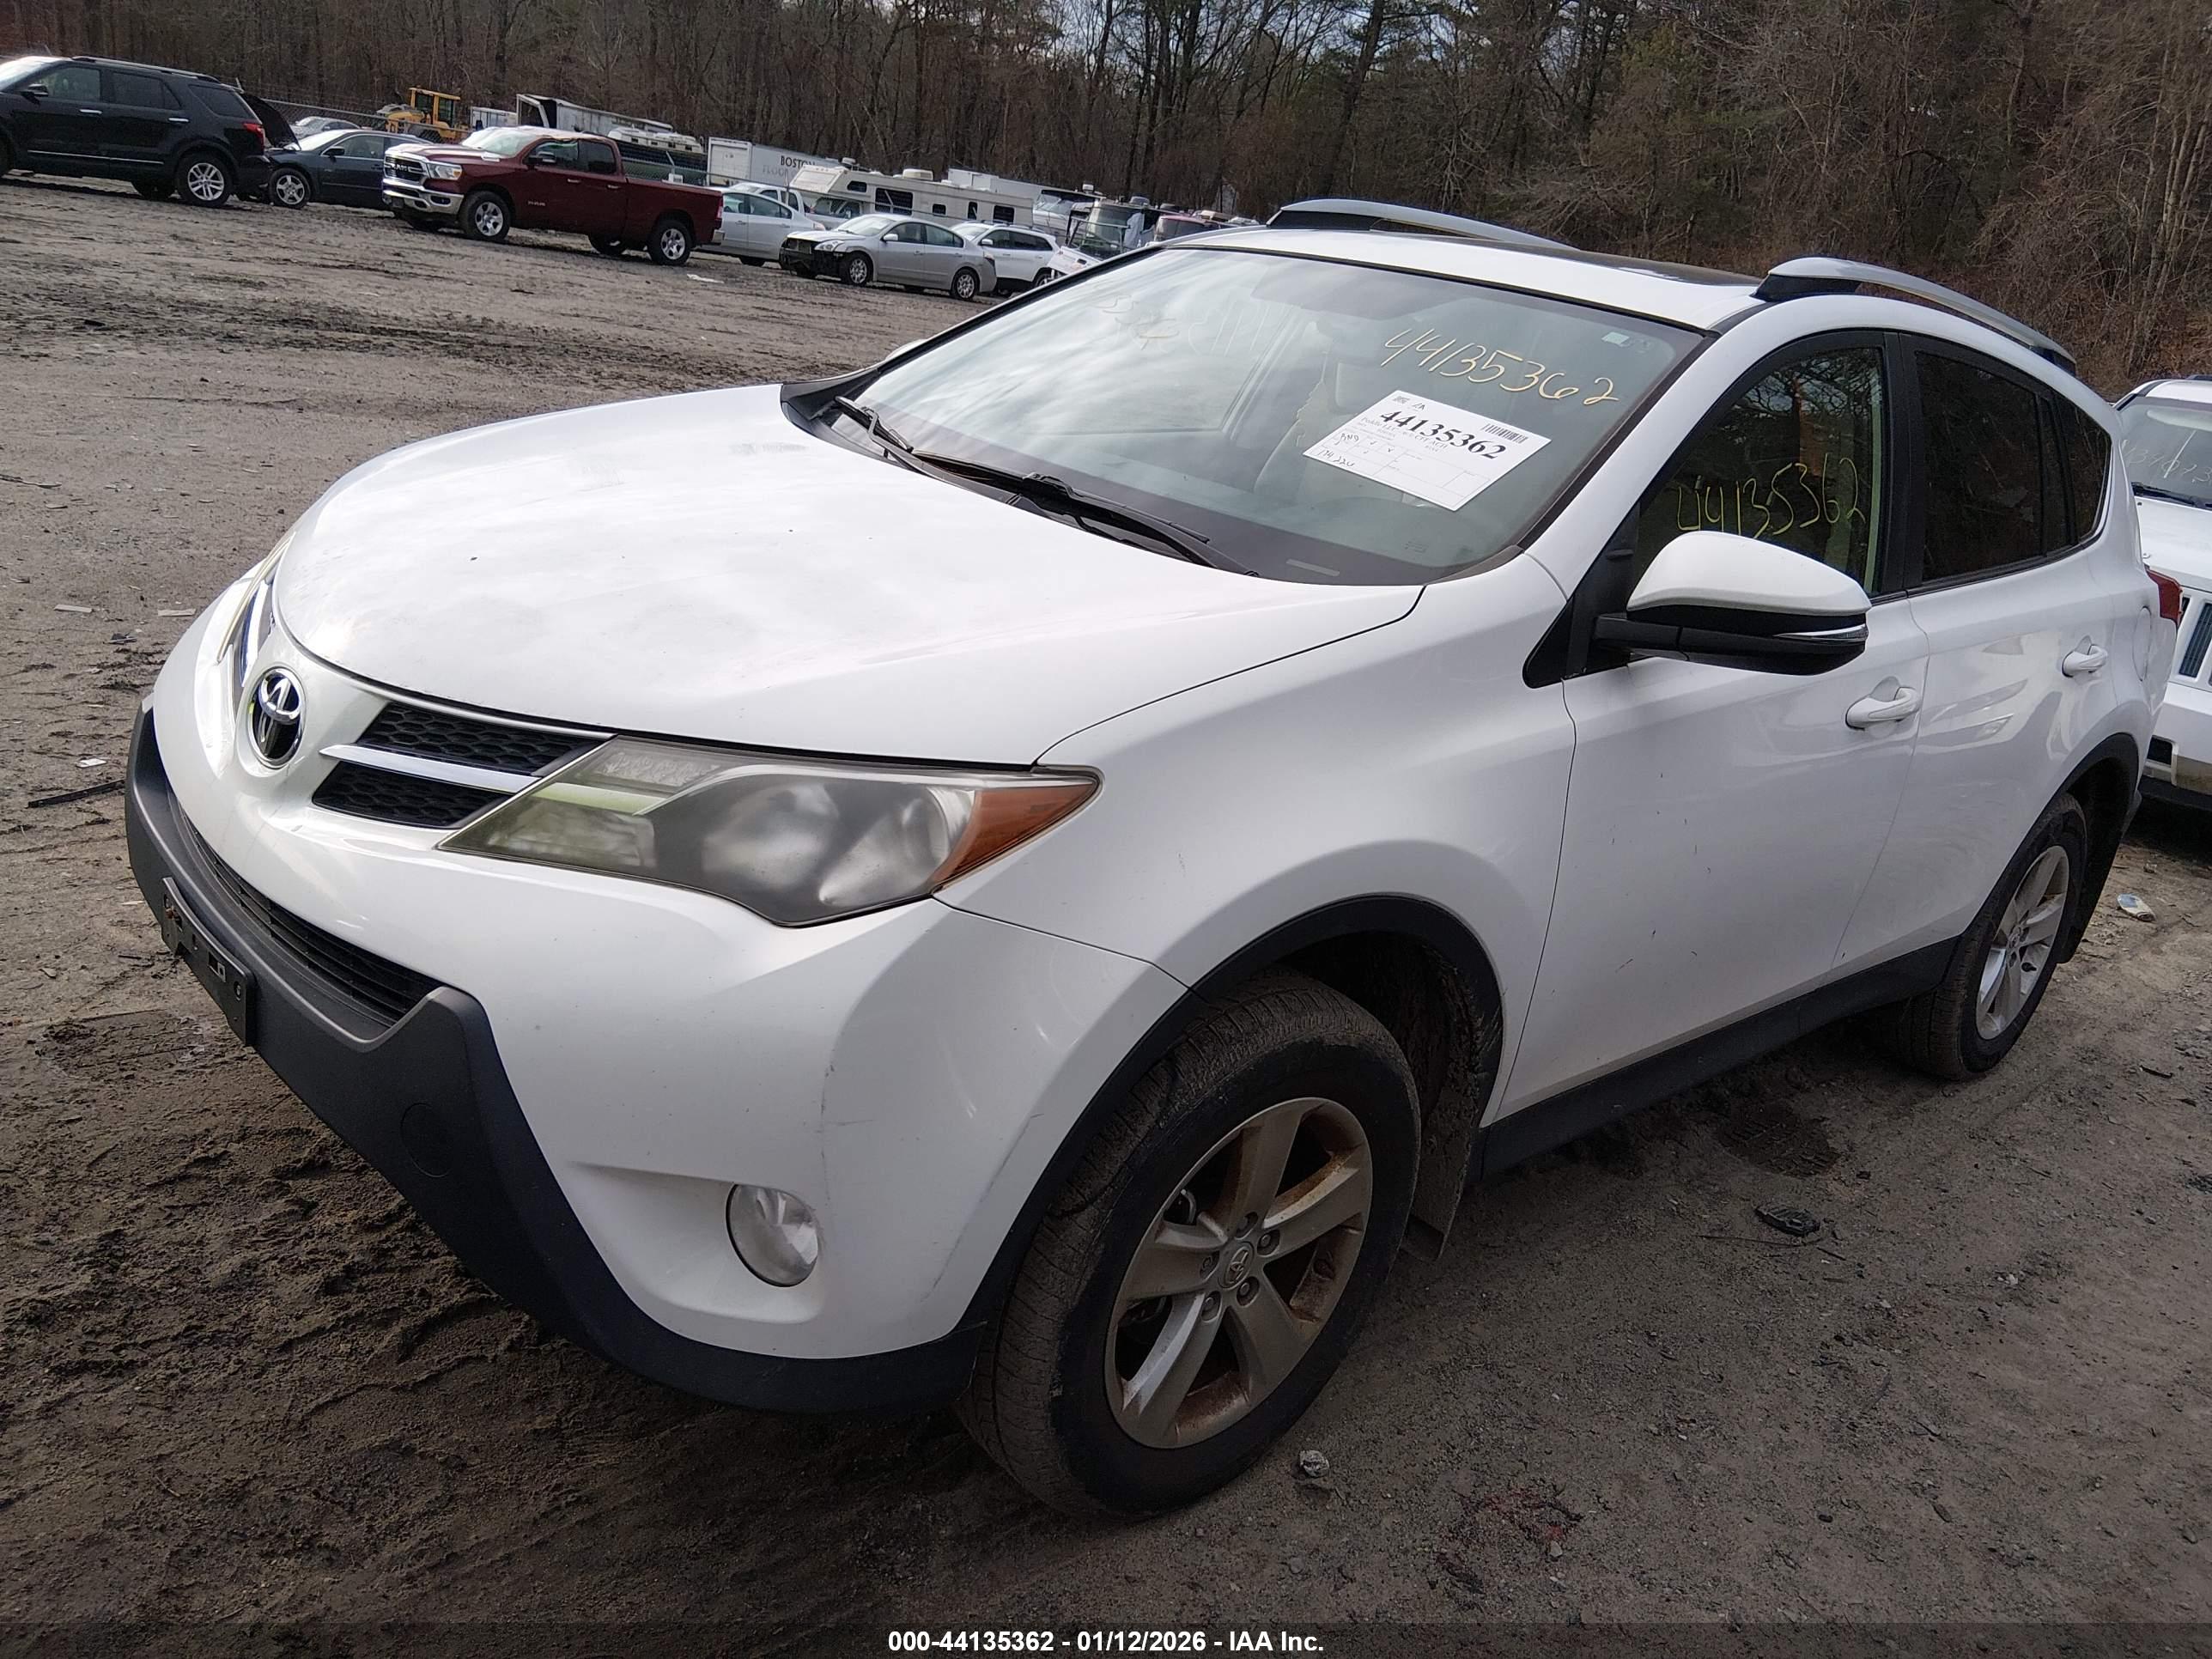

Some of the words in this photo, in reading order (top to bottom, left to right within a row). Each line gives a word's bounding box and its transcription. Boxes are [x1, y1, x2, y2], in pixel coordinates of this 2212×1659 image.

[1381, 328, 1620, 404] 44135362
[1379, 410, 1506, 459] 44135362
[1677, 453, 1866, 539] 44135362
